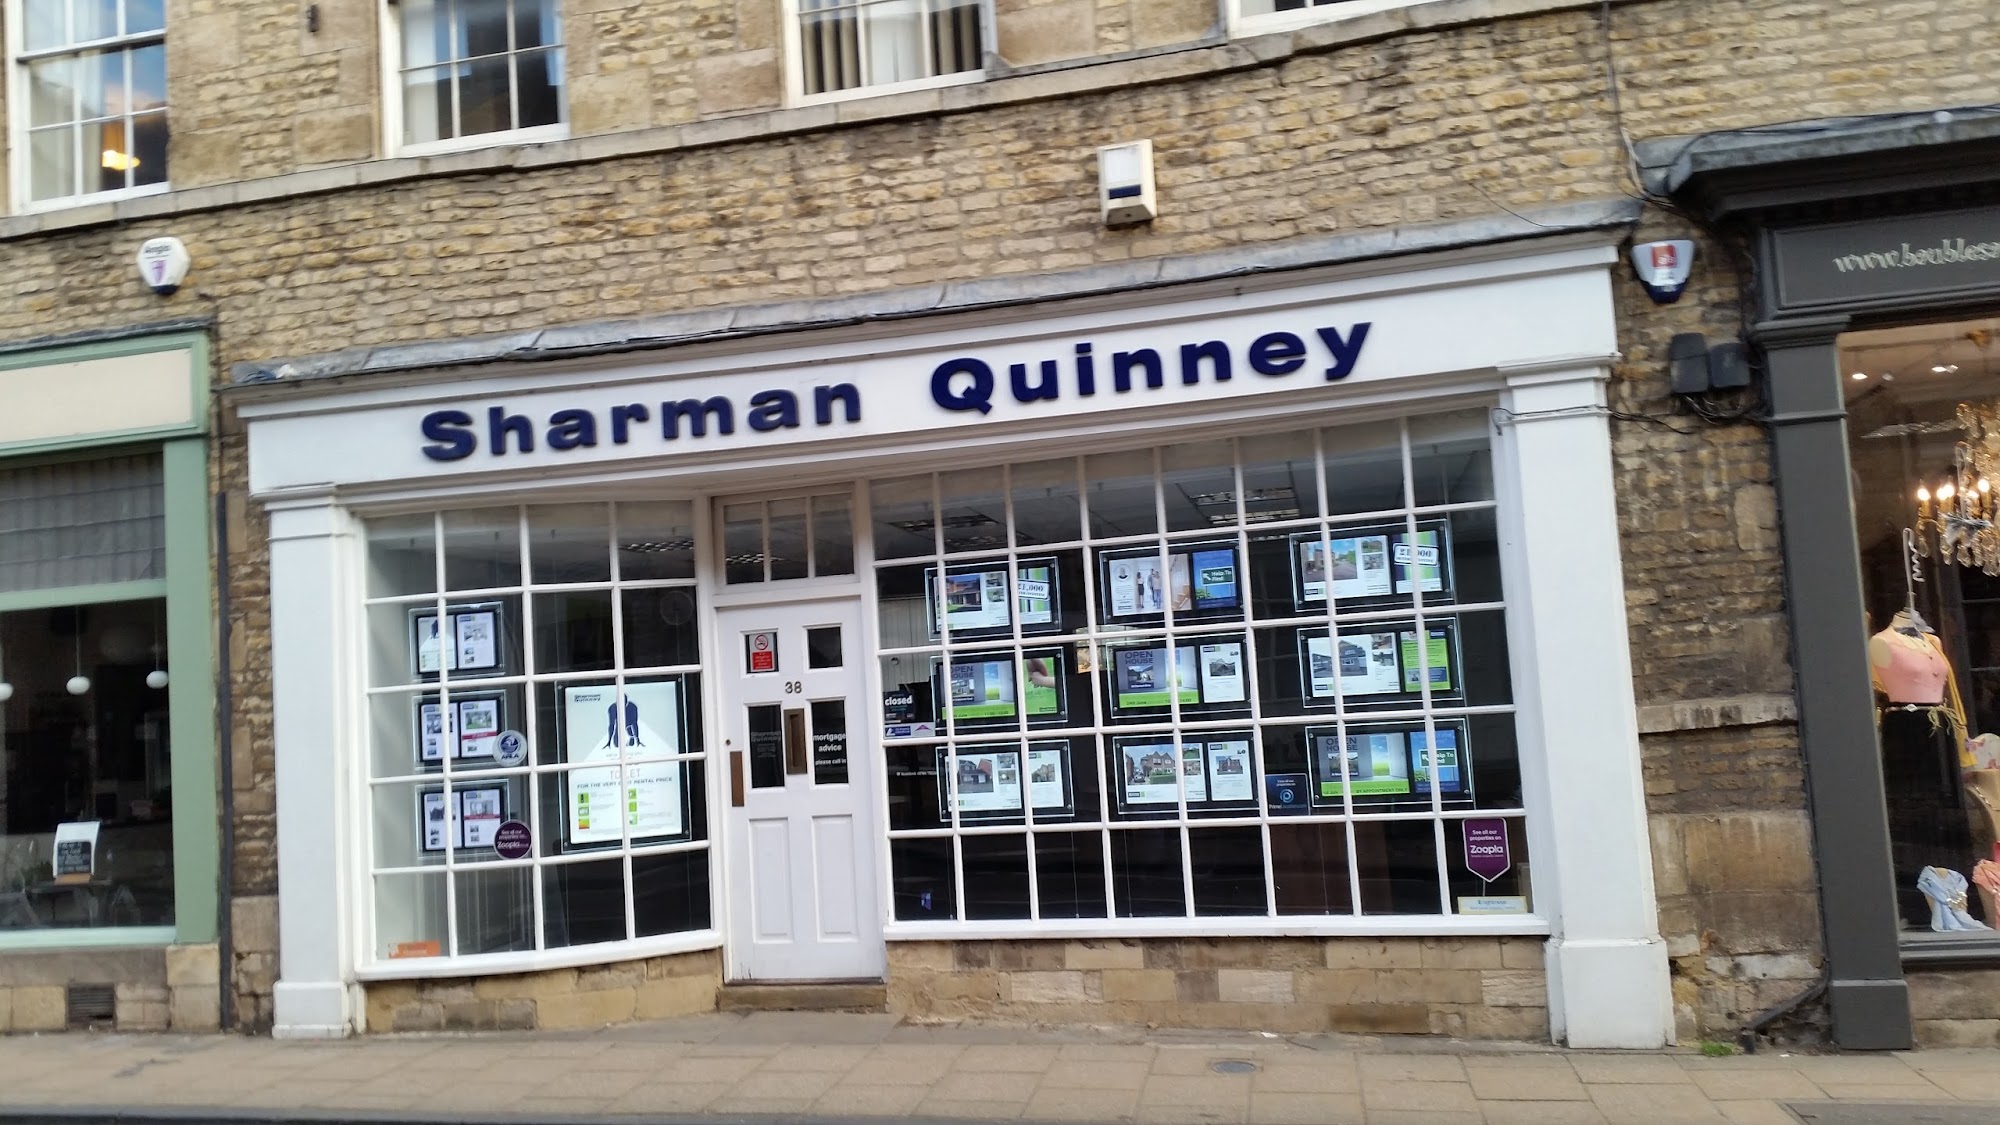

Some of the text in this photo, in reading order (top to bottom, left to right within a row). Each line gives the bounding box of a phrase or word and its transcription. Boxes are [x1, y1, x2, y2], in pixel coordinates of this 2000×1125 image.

[421, 321, 1372, 461] Sharman Quinney
[1125, 651, 1153, 659] OPEN
[951, 665, 974, 673] PEN
[785, 681, 803, 694] 38
[884, 695, 913, 706] closed
[813, 733, 847, 742] mortgage
[818, 744, 843, 752] advice
[1469, 845, 1504, 855] Zoopla
